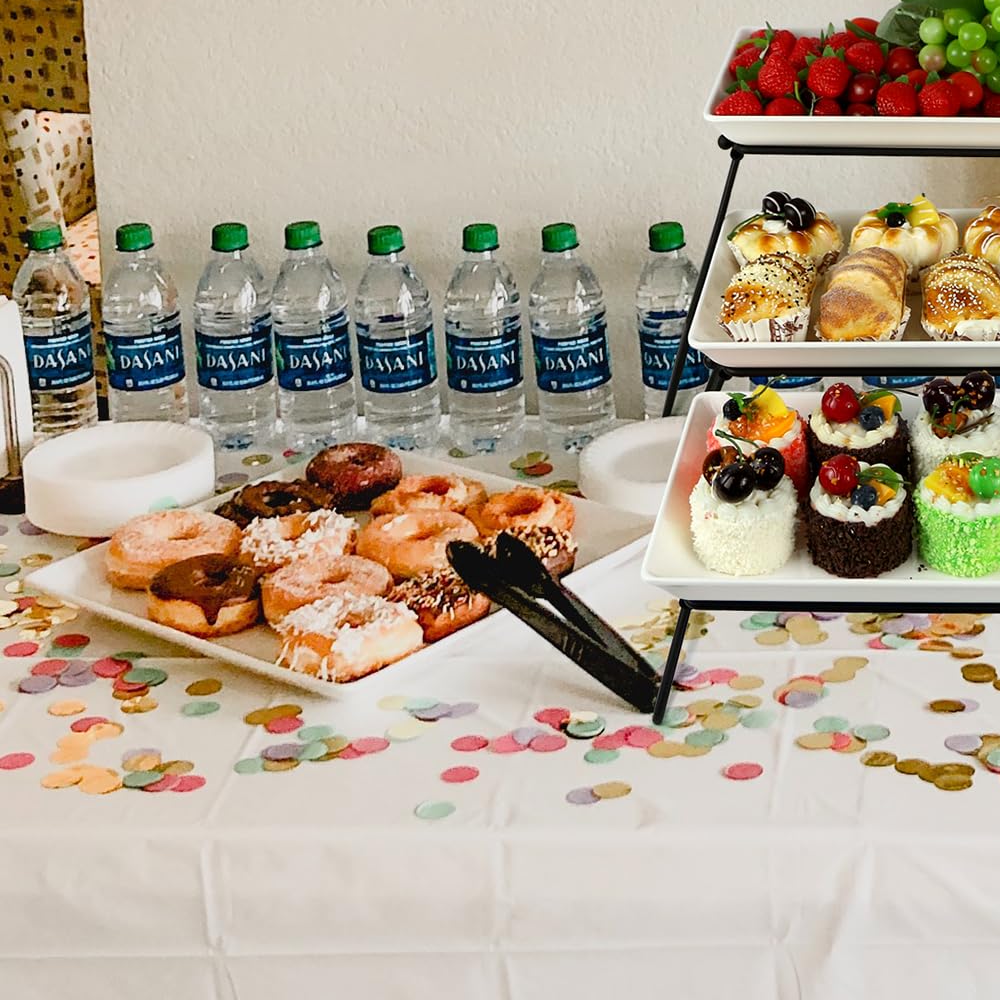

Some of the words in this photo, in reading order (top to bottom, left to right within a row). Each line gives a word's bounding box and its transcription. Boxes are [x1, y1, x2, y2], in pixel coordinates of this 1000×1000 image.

[33, 344, 91, 370] DASANI
[120, 345, 179, 370] DASANI
[206, 348, 266, 371] DASANI
[289, 347, 347, 371] DASANI
[365, 350, 424, 374] DASANI
[457, 350, 516, 374] DASANI
[545, 347, 604, 373] DASANI
[644, 349, 702, 370] DASNI
